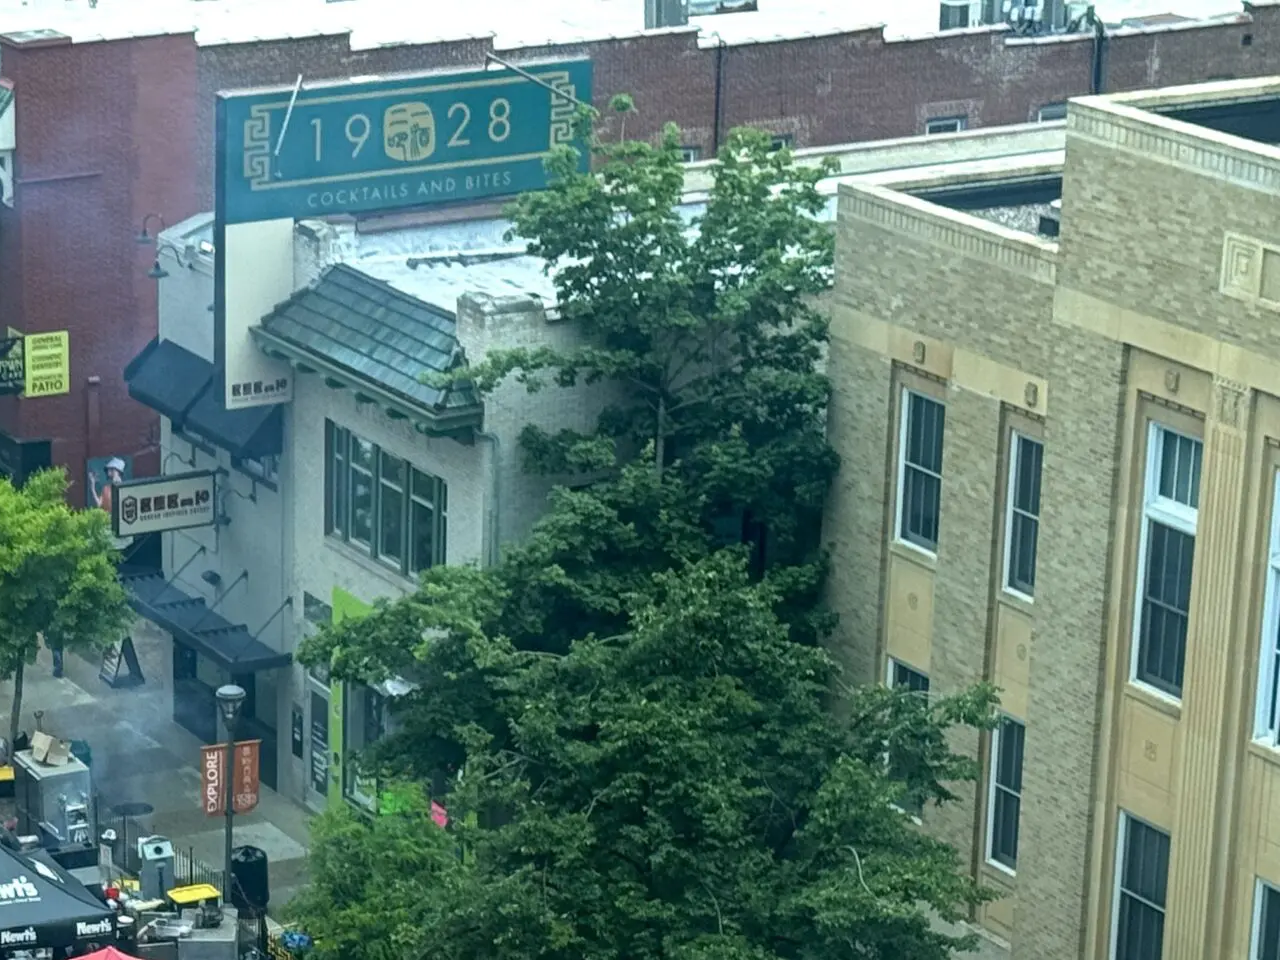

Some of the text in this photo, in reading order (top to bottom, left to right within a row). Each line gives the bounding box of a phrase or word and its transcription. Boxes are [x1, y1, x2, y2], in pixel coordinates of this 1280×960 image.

[307, 171, 513, 207] COCKTAILS AND BITES
[32, 380, 63, 393] PATIO
[206, 751, 219, 812] EXPLORE
[0, 927, 38, 945] Newt's
[76, 918, 112, 936] Newt's
